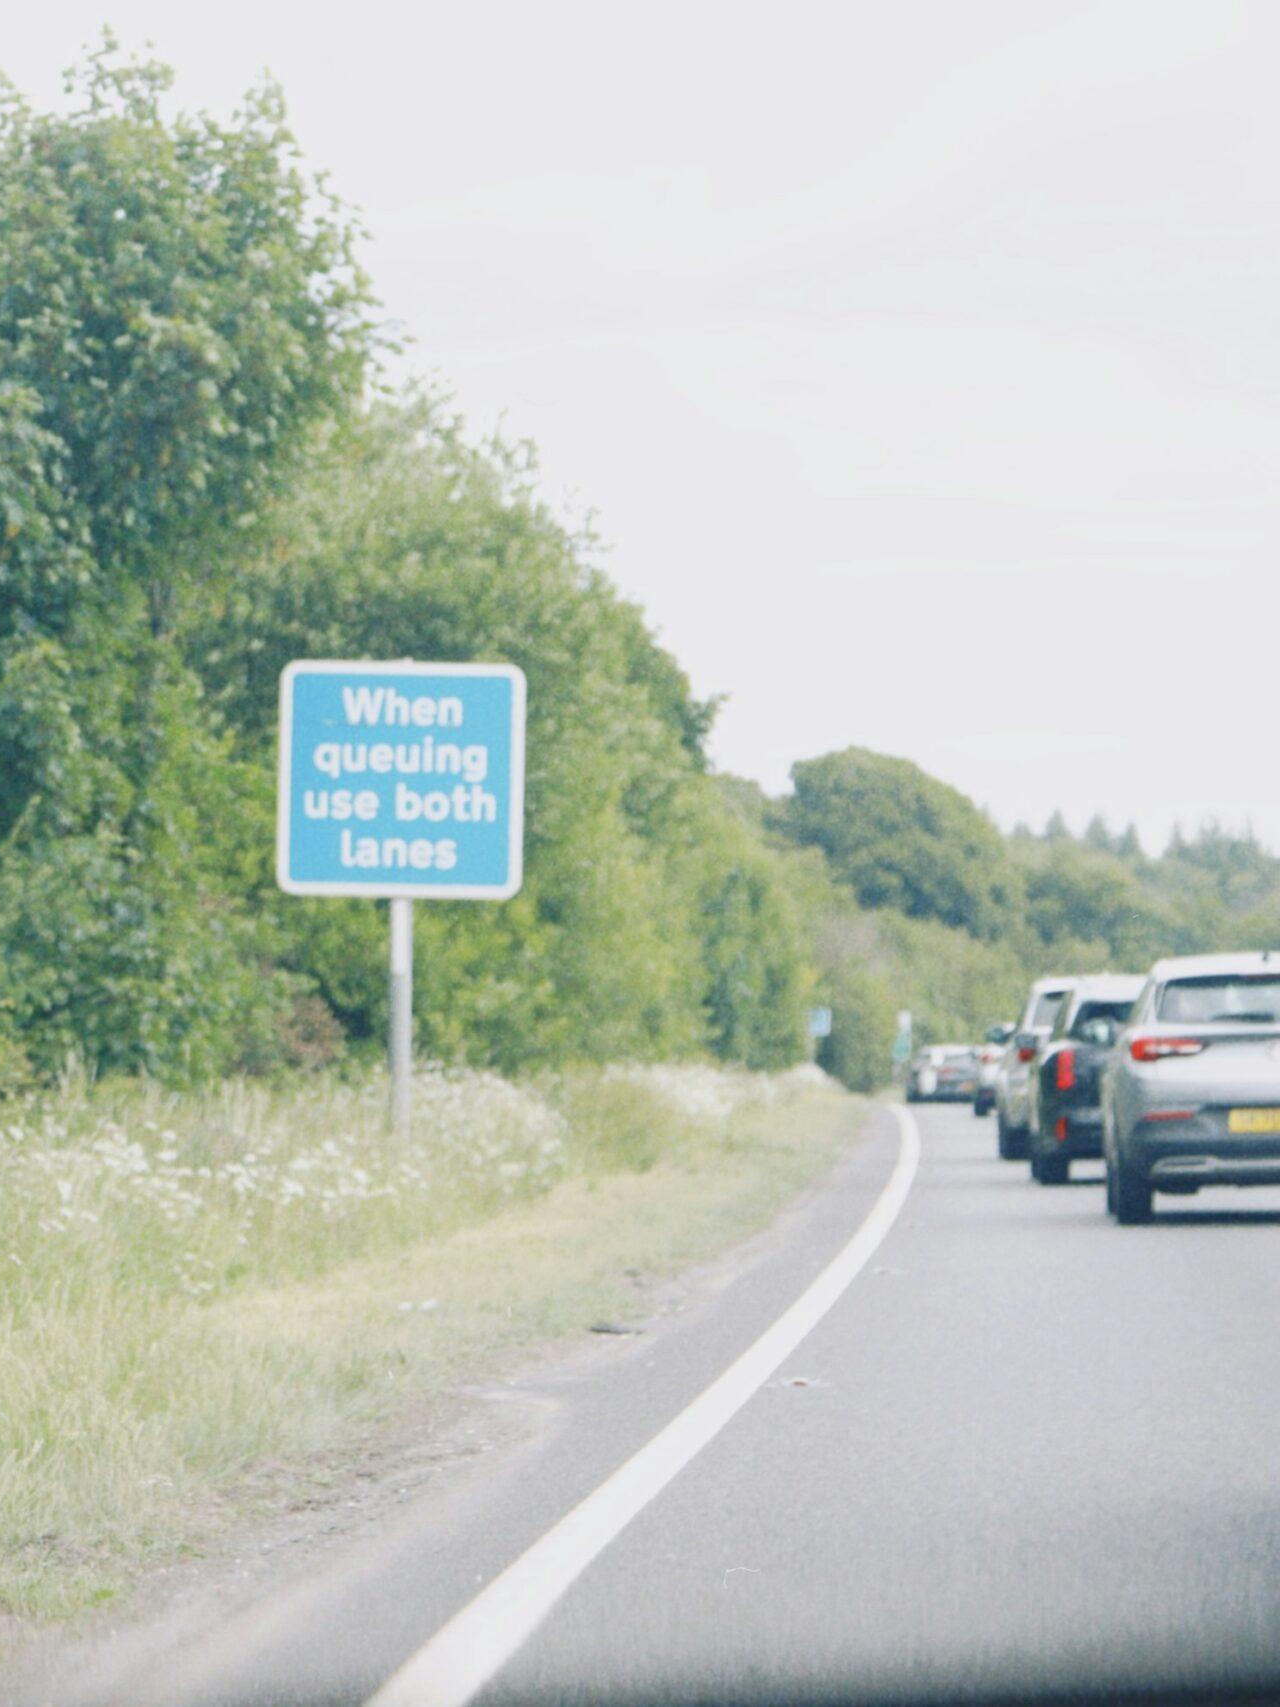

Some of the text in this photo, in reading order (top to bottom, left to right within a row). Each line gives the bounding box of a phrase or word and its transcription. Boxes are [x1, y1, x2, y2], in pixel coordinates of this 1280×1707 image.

[341, 686, 463, 727] When
[313, 736, 487, 783] queuing
[303, 782, 497, 823] use both
[340, 829, 457, 870] lanes
